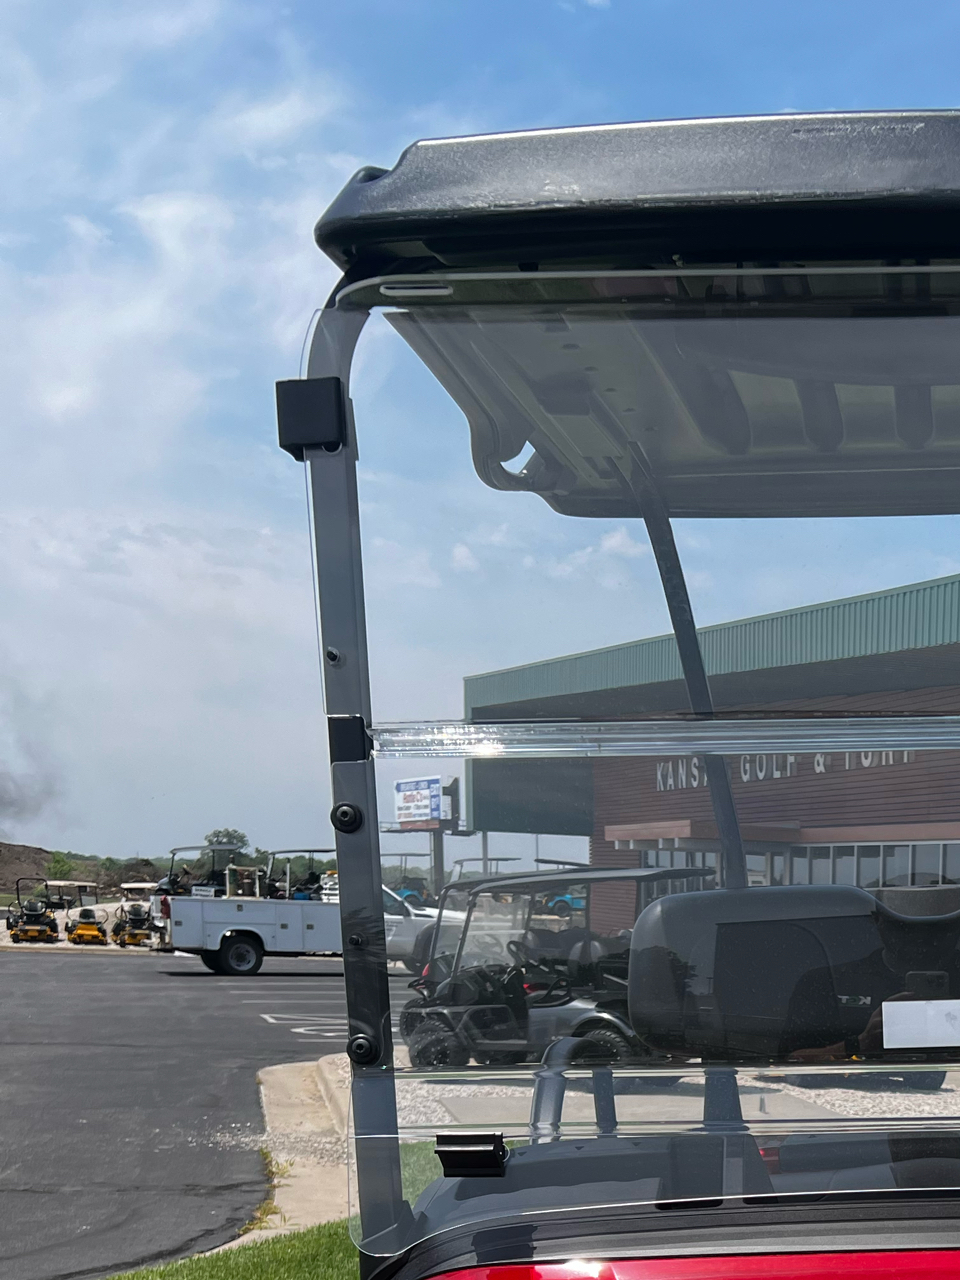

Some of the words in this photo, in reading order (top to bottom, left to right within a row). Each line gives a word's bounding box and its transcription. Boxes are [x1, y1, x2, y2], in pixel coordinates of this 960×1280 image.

[656, 756, 708, 792] KANS
[740, 754, 796, 783] GOLF
[814, 753, 826, 773] &
